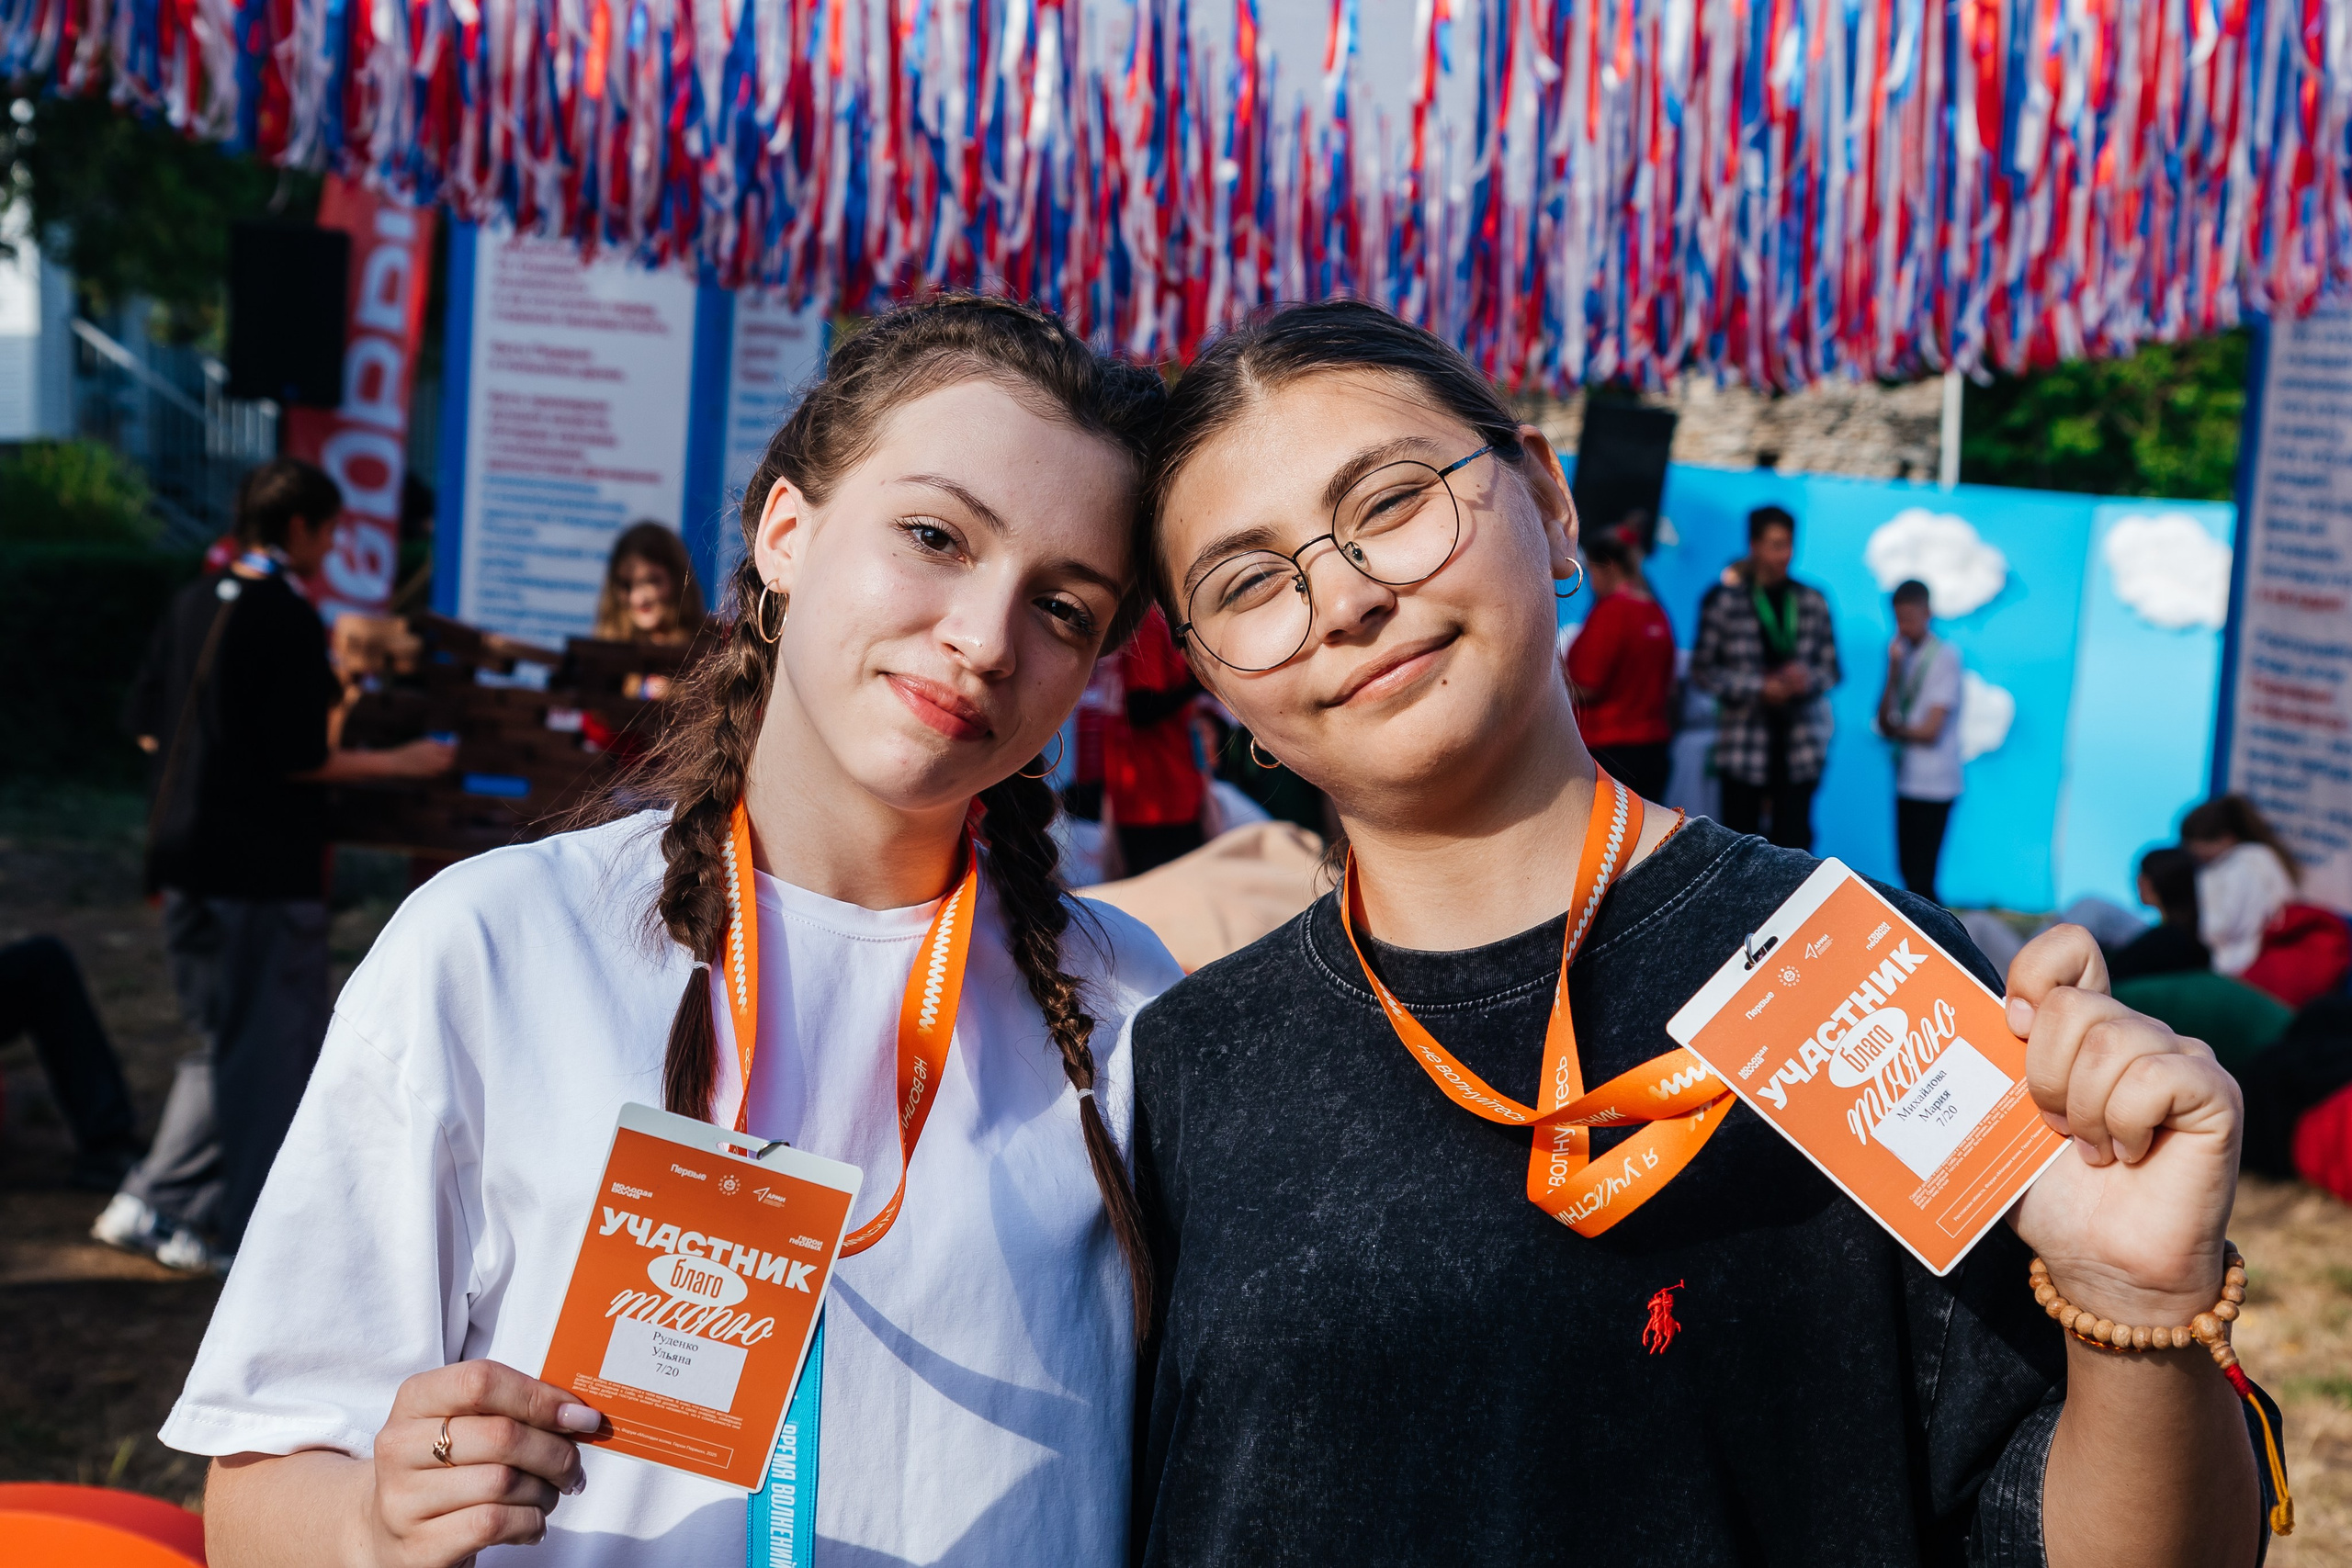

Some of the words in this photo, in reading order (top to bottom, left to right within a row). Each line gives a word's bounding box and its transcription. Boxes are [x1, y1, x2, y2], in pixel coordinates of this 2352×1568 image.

[1745, 991, 1774, 1020] Первые
[1757, 937, 1928, 1111] УЧАСТНИК
[1840, 1024, 1894, 1073] благо
[1896, 1070, 1947, 1121] Михайлова
[1918, 1090, 1951, 1122] Мария
[1936, 1105, 1957, 1126] 7/20
[671, 1163, 707, 1180] Первые
[1553, 1156, 1642, 1226] участни
[599, 1206, 817, 1294] УЧАСТНИК
[670, 1258, 724, 1299] благо
[652, 1331, 698, 1351] Руденко
[652, 1346, 691, 1365] Ульяна
[656, 1362, 679, 1377] 7/20
[769, 1483, 797, 1568] ВОЛНЕНИЙ
